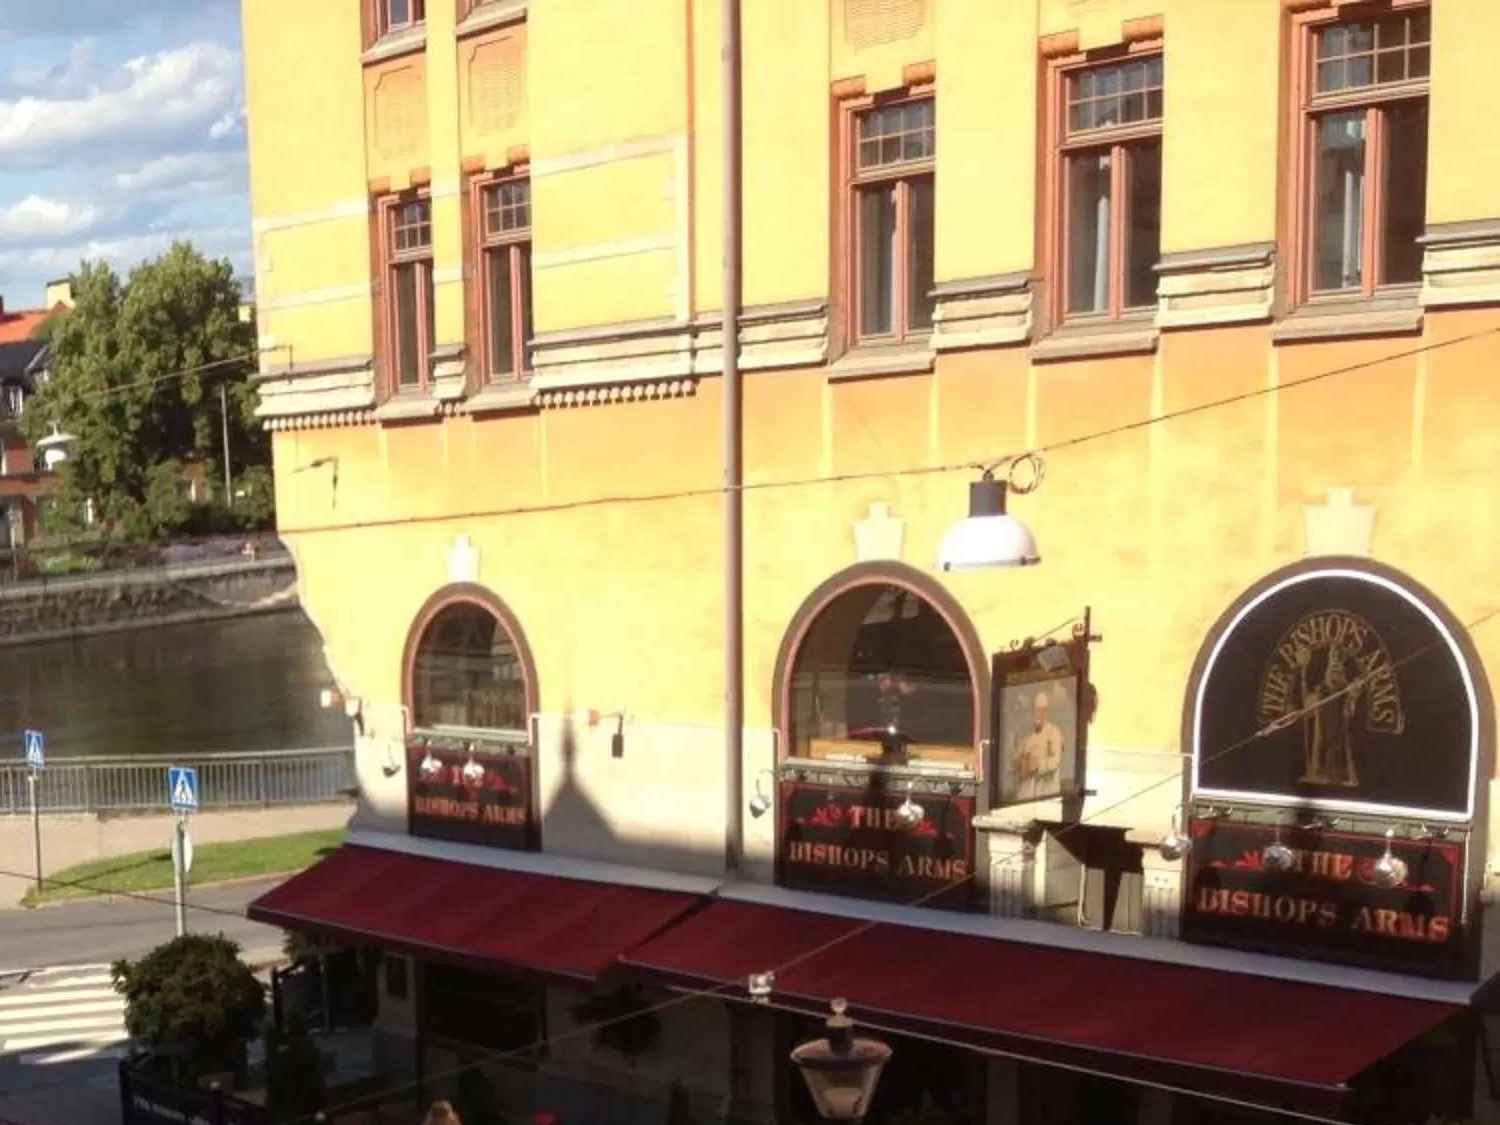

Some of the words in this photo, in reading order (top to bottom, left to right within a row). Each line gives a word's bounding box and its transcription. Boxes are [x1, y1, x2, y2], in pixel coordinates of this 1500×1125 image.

[1262, 665, 1288, 717] THE
[1280, 614, 1368, 669] BISHOPS
[1364, 649, 1397, 722] ARMS
[850, 805, 899, 830] THE
[789, 841, 890, 871] BISHOPS
[897, 855, 967, 880] ARMS
[1198, 887, 1338, 928] BISHOPS
[1352, 905, 1450, 944] ARMS
